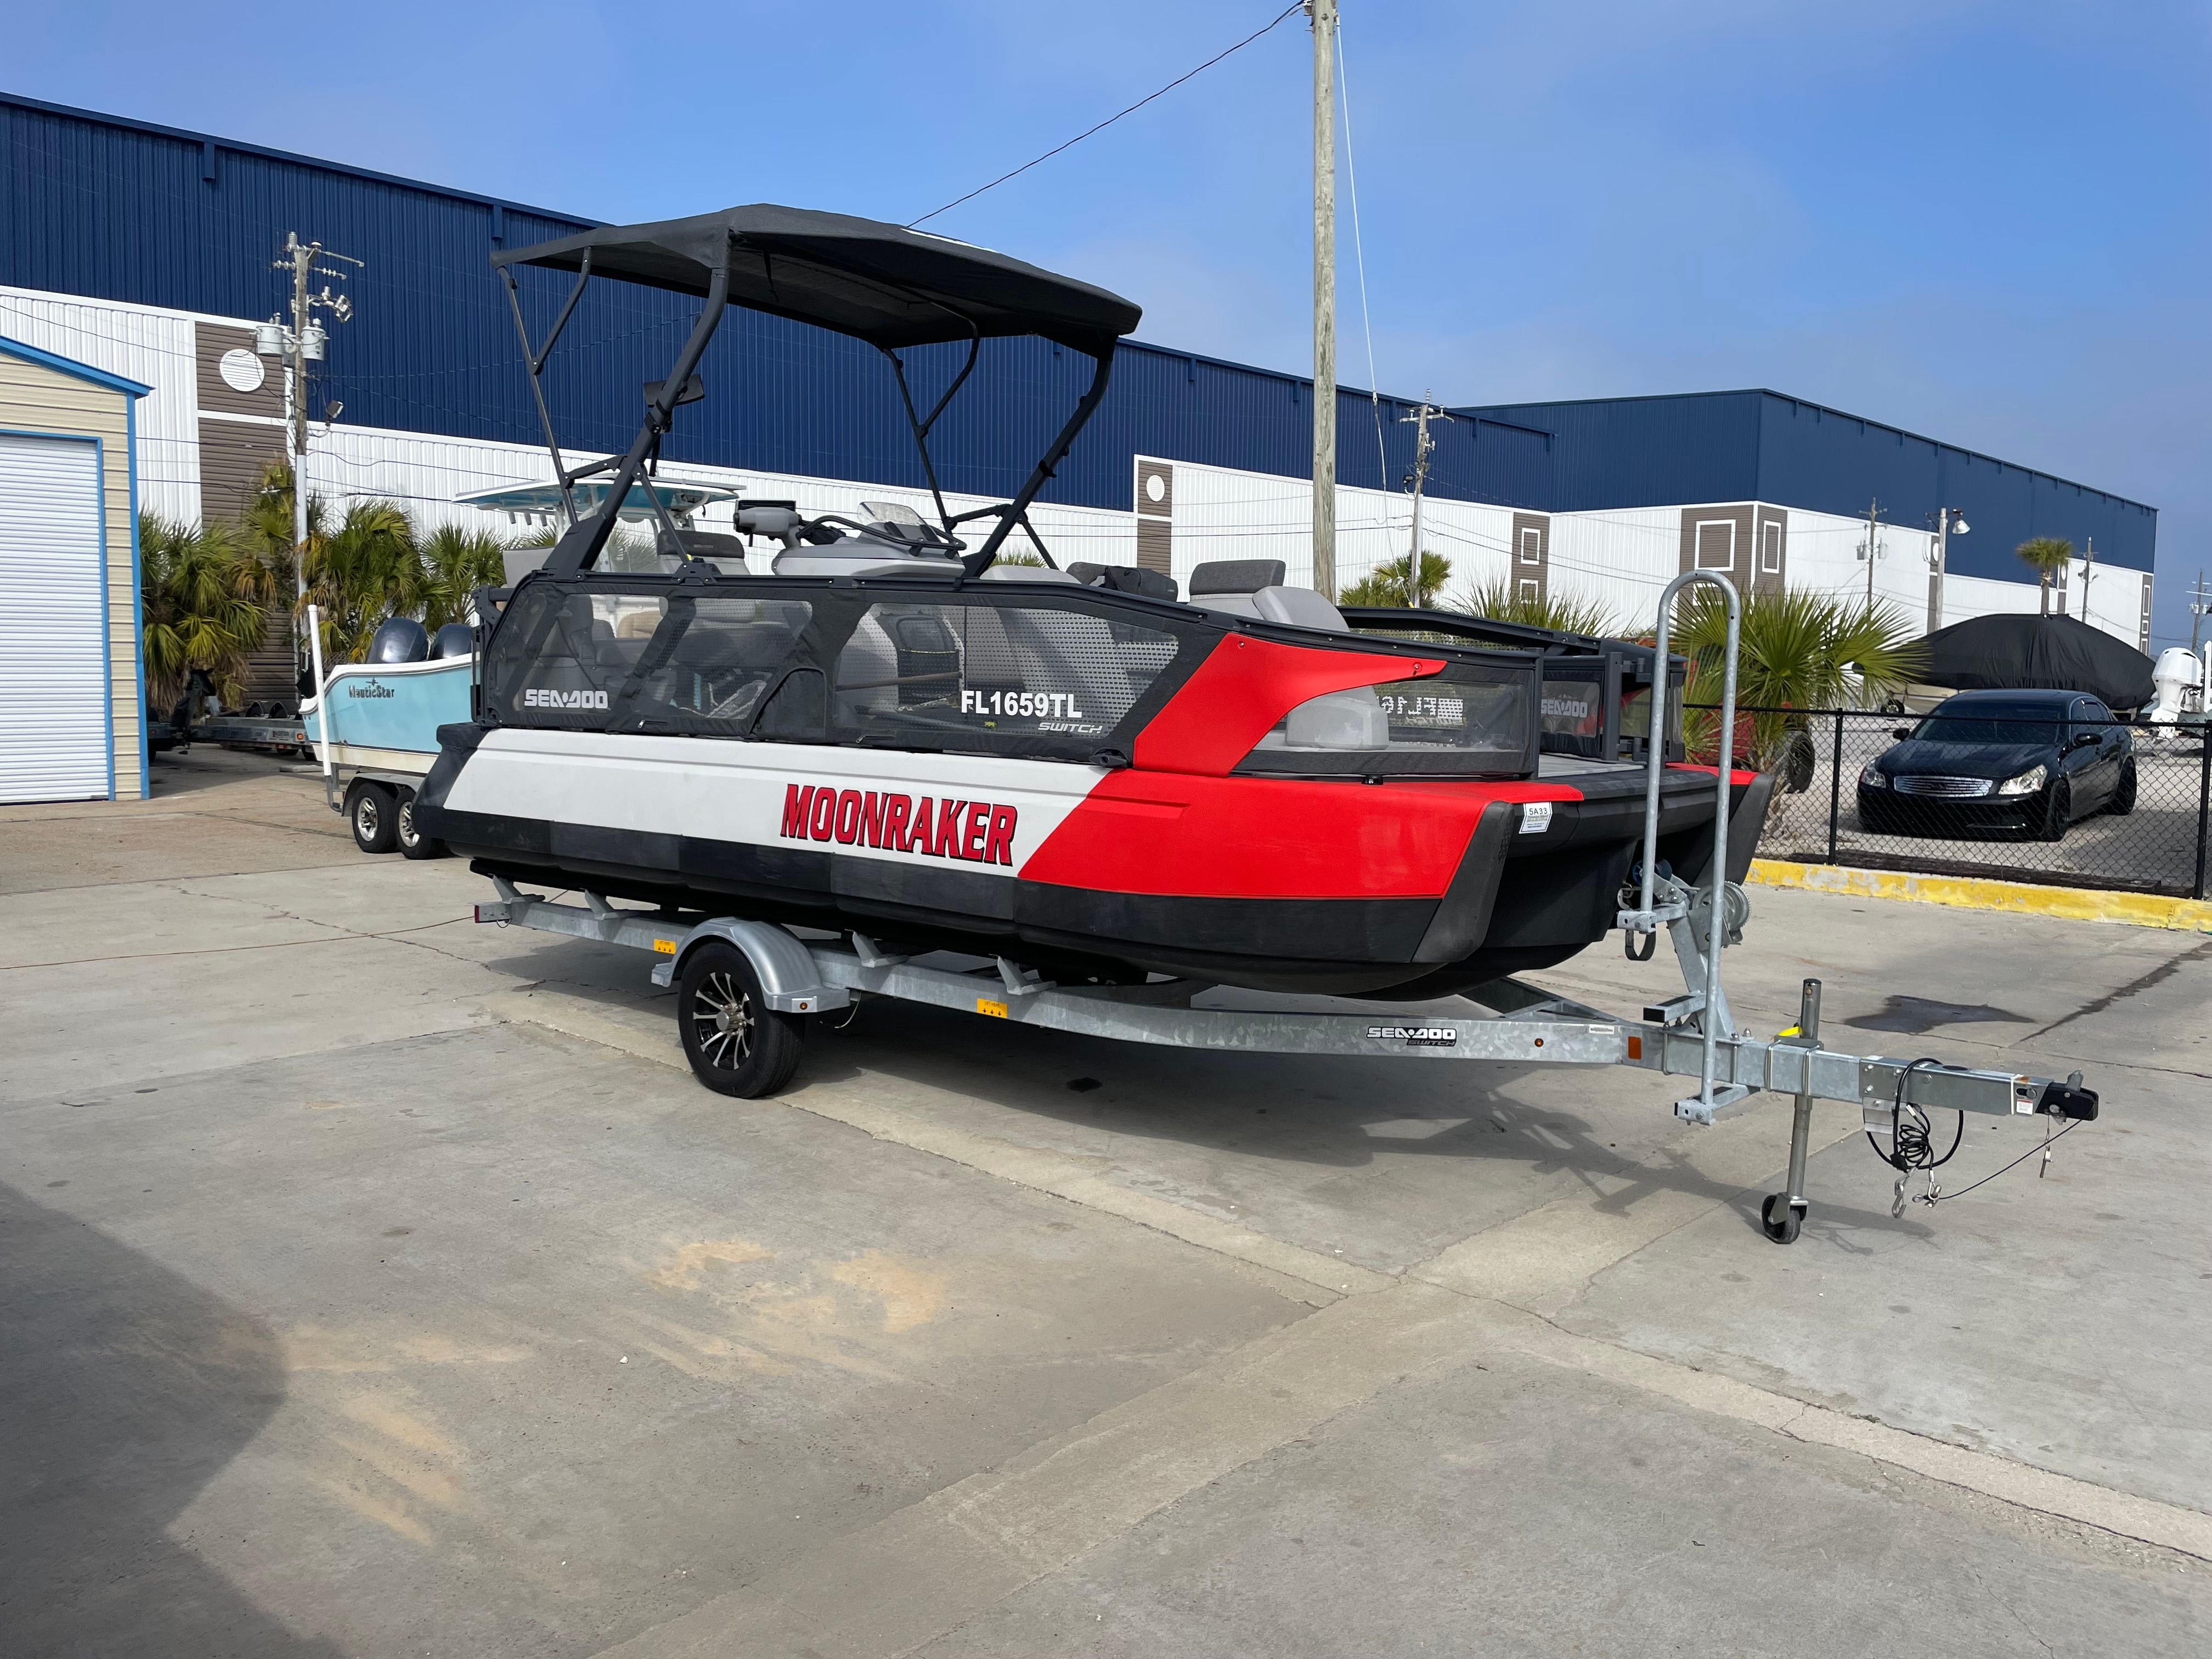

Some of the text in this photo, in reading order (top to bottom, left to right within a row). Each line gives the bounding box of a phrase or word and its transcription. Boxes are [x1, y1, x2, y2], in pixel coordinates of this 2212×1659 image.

[349, 685, 395, 698] NauticStar
[961, 690, 1082, 718] FL1659TL
[1038, 722, 1103, 734] SWITCH
[780, 783, 1018, 867] MOONRAKER
